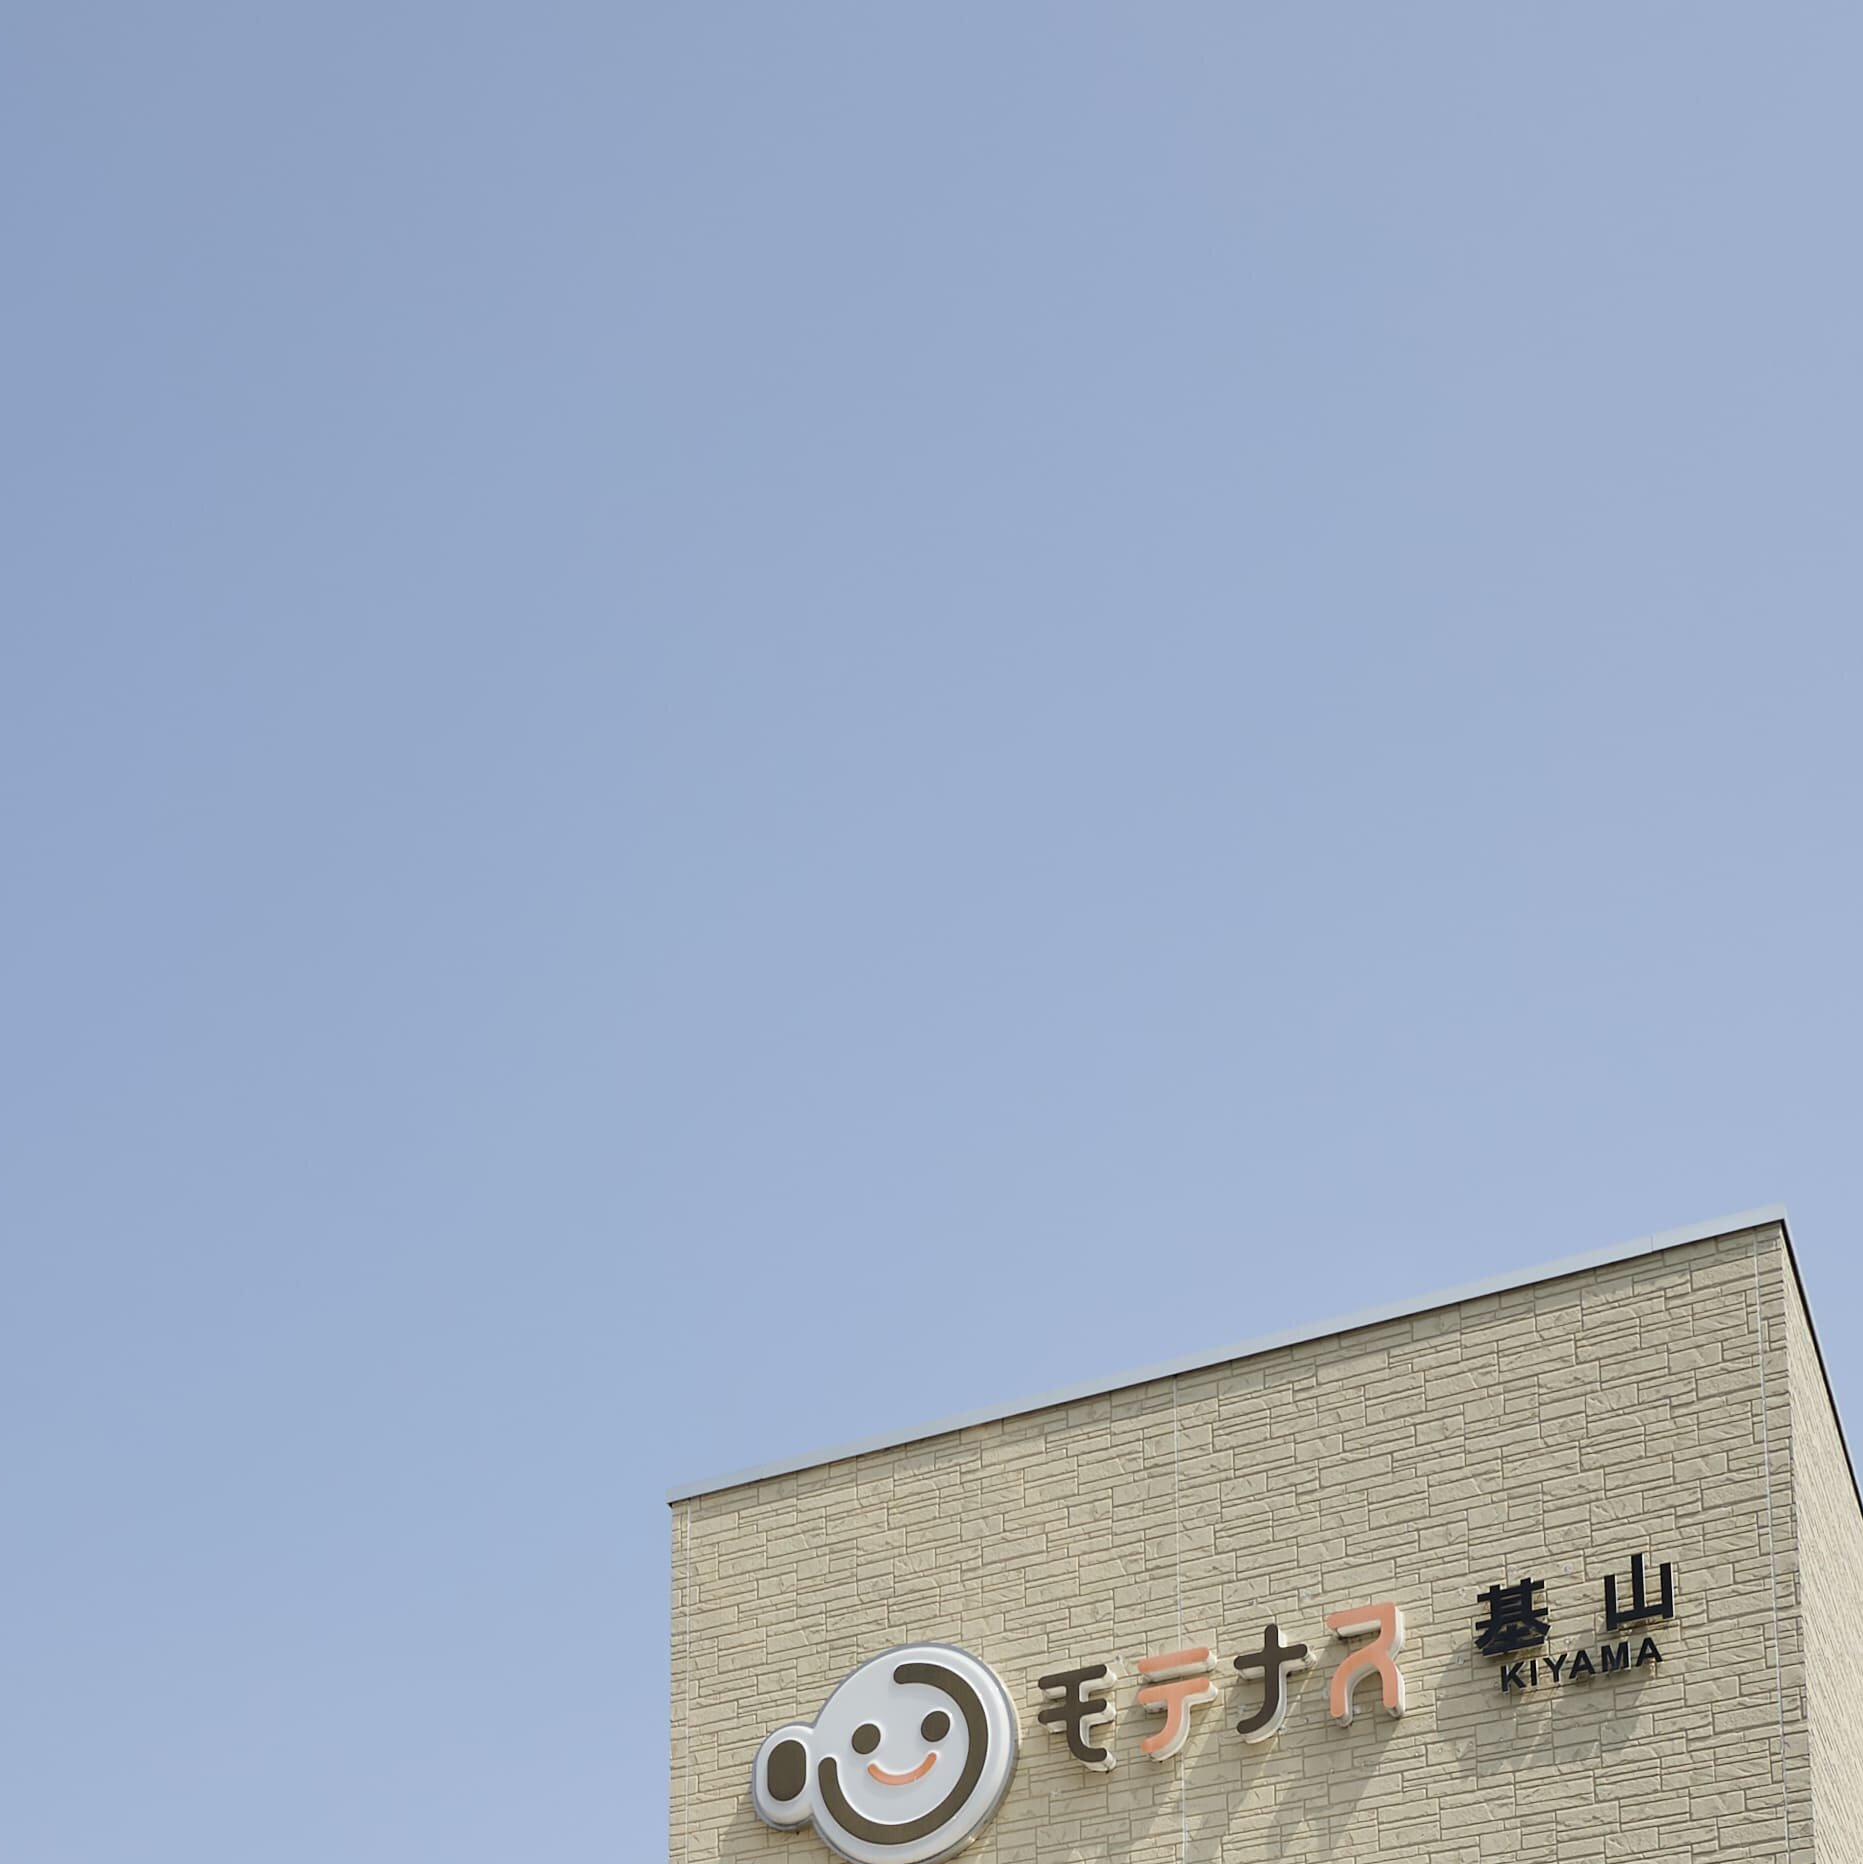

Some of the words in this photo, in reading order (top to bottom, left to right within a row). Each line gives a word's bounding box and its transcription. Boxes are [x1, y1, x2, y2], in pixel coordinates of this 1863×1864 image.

[1037, 1601, 1406, 1774] モテナス
[1500, 1637, 1663, 1693] KIYAMA
